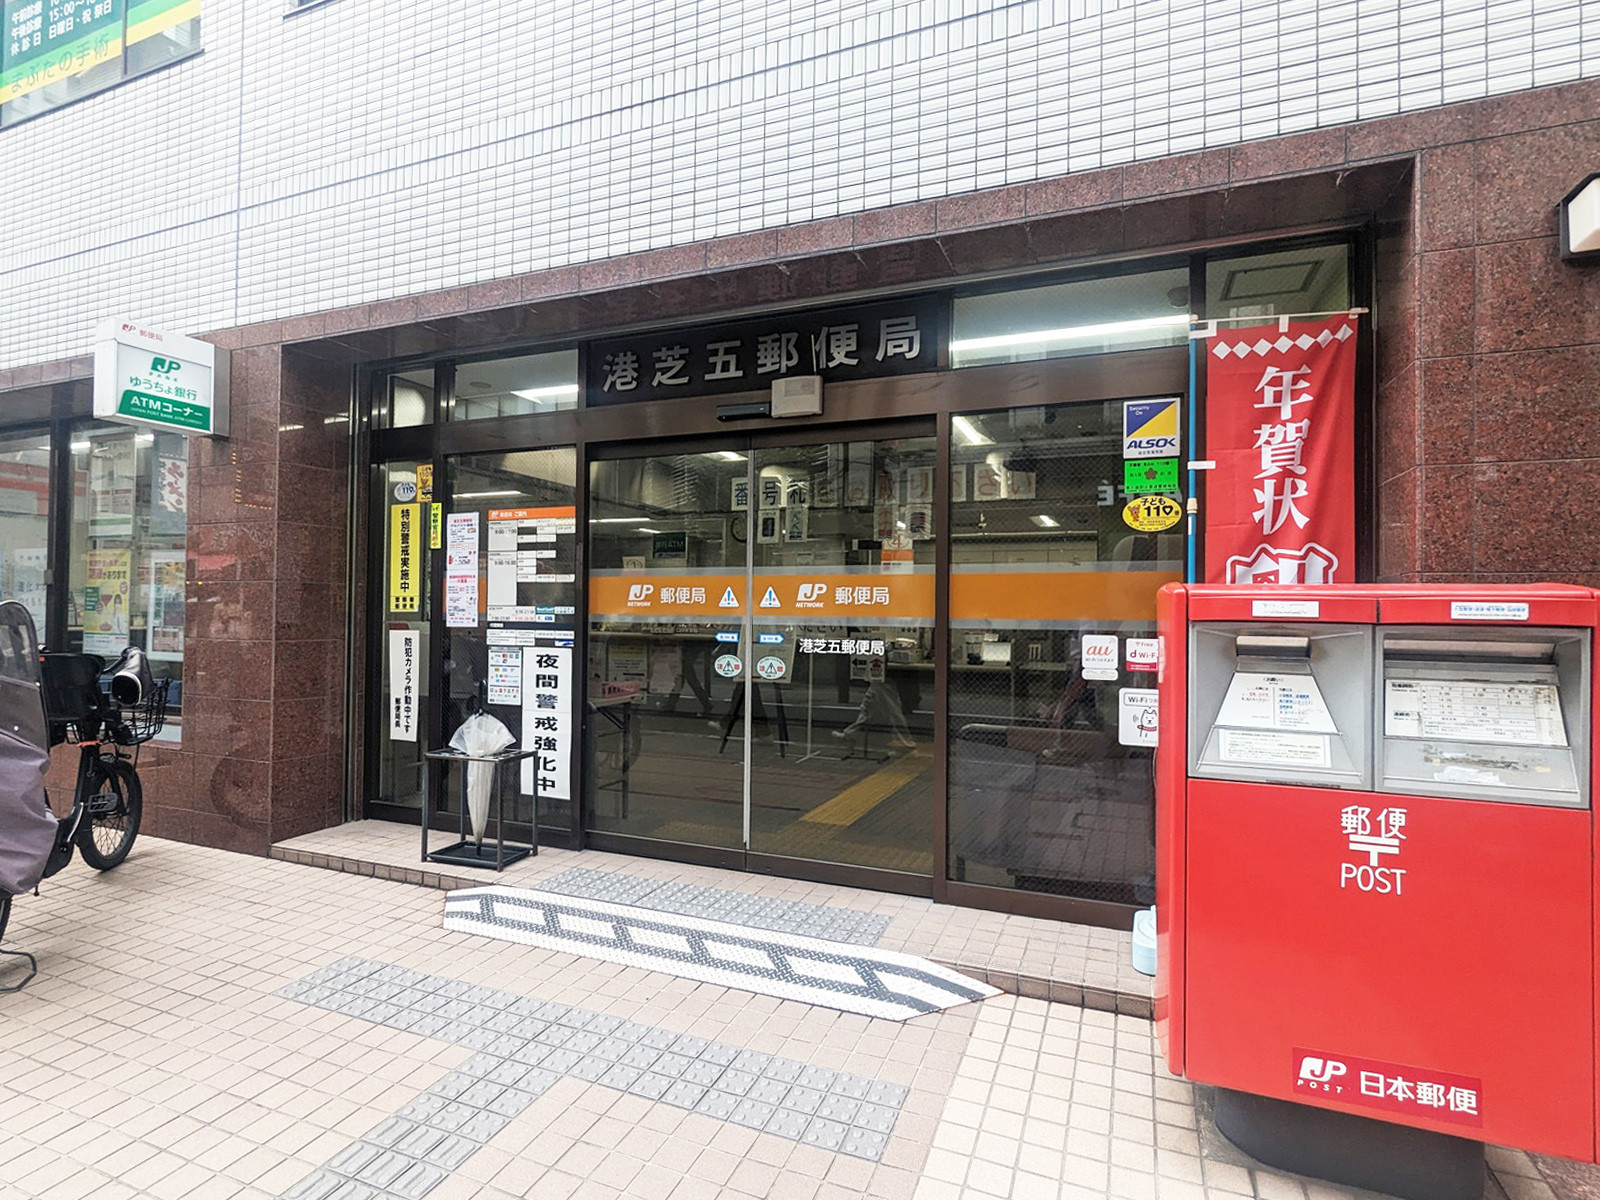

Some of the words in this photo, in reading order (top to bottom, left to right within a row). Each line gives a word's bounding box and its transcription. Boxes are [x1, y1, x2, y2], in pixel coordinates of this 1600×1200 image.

[11, 32, 41, 56] 休診日
[150, 357, 181, 374] JP
[602, 315, 921, 393] 港芝五郵便局
[130, 376, 198, 400] ゆうちょ銀行
[131, 396, 203, 417] ATMコーナー
[1127, 438, 1176, 450] ALSOK
[1252, 364, 1314, 535] 年賀状
[401, 509, 410, 592] 特別警戒実施中
[628, 584, 654, 601] JP
[660, 587, 706, 604] 郵便局
[796, 583, 827, 602] JP
[835, 586, 890, 606] 郵便局
[799, 638, 885, 656] 港芝五郵便局
[1086, 645, 1113, 656] au
[404, 638, 412, 733] 防犯カメラ作動中です
[534, 654, 560, 792] 夜間警戒強化中
[1341, 805, 1407, 839] 郵便
[1340, 863, 1406, 895] POST
[1297, 1079, 1342, 1094] POST
[1300, 1056, 1347, 1082] JP
[1360, 1070, 1478, 1115] 日本郵便
